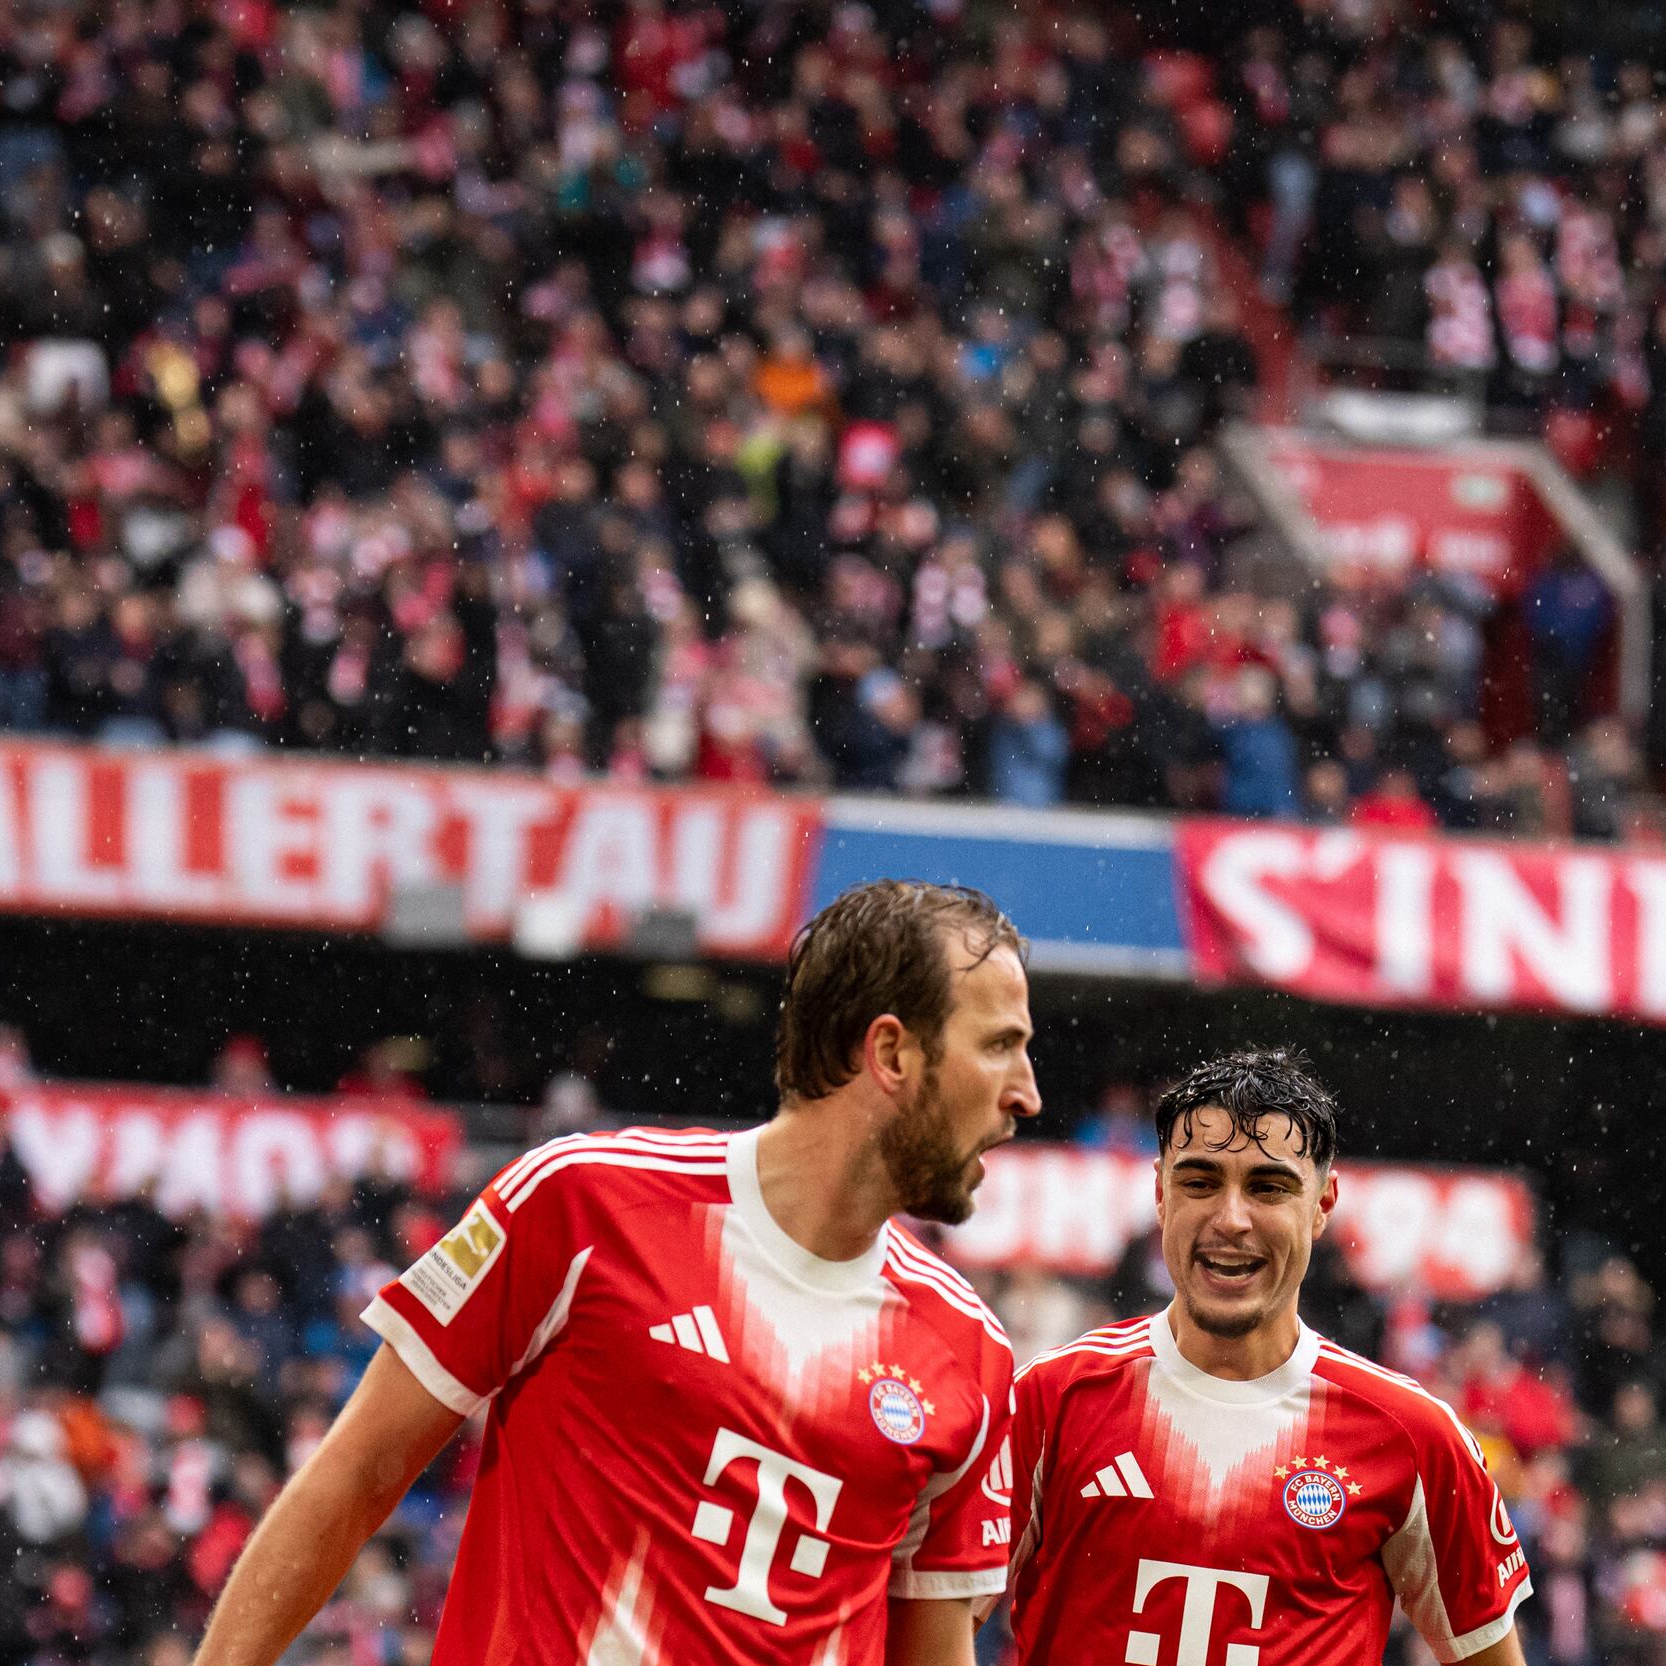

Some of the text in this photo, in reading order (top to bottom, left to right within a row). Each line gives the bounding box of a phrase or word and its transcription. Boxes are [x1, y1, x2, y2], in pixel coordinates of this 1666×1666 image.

[690, 1426, 844, 1628] T
[1290, 1474, 1342, 1502] FC BAYERN
